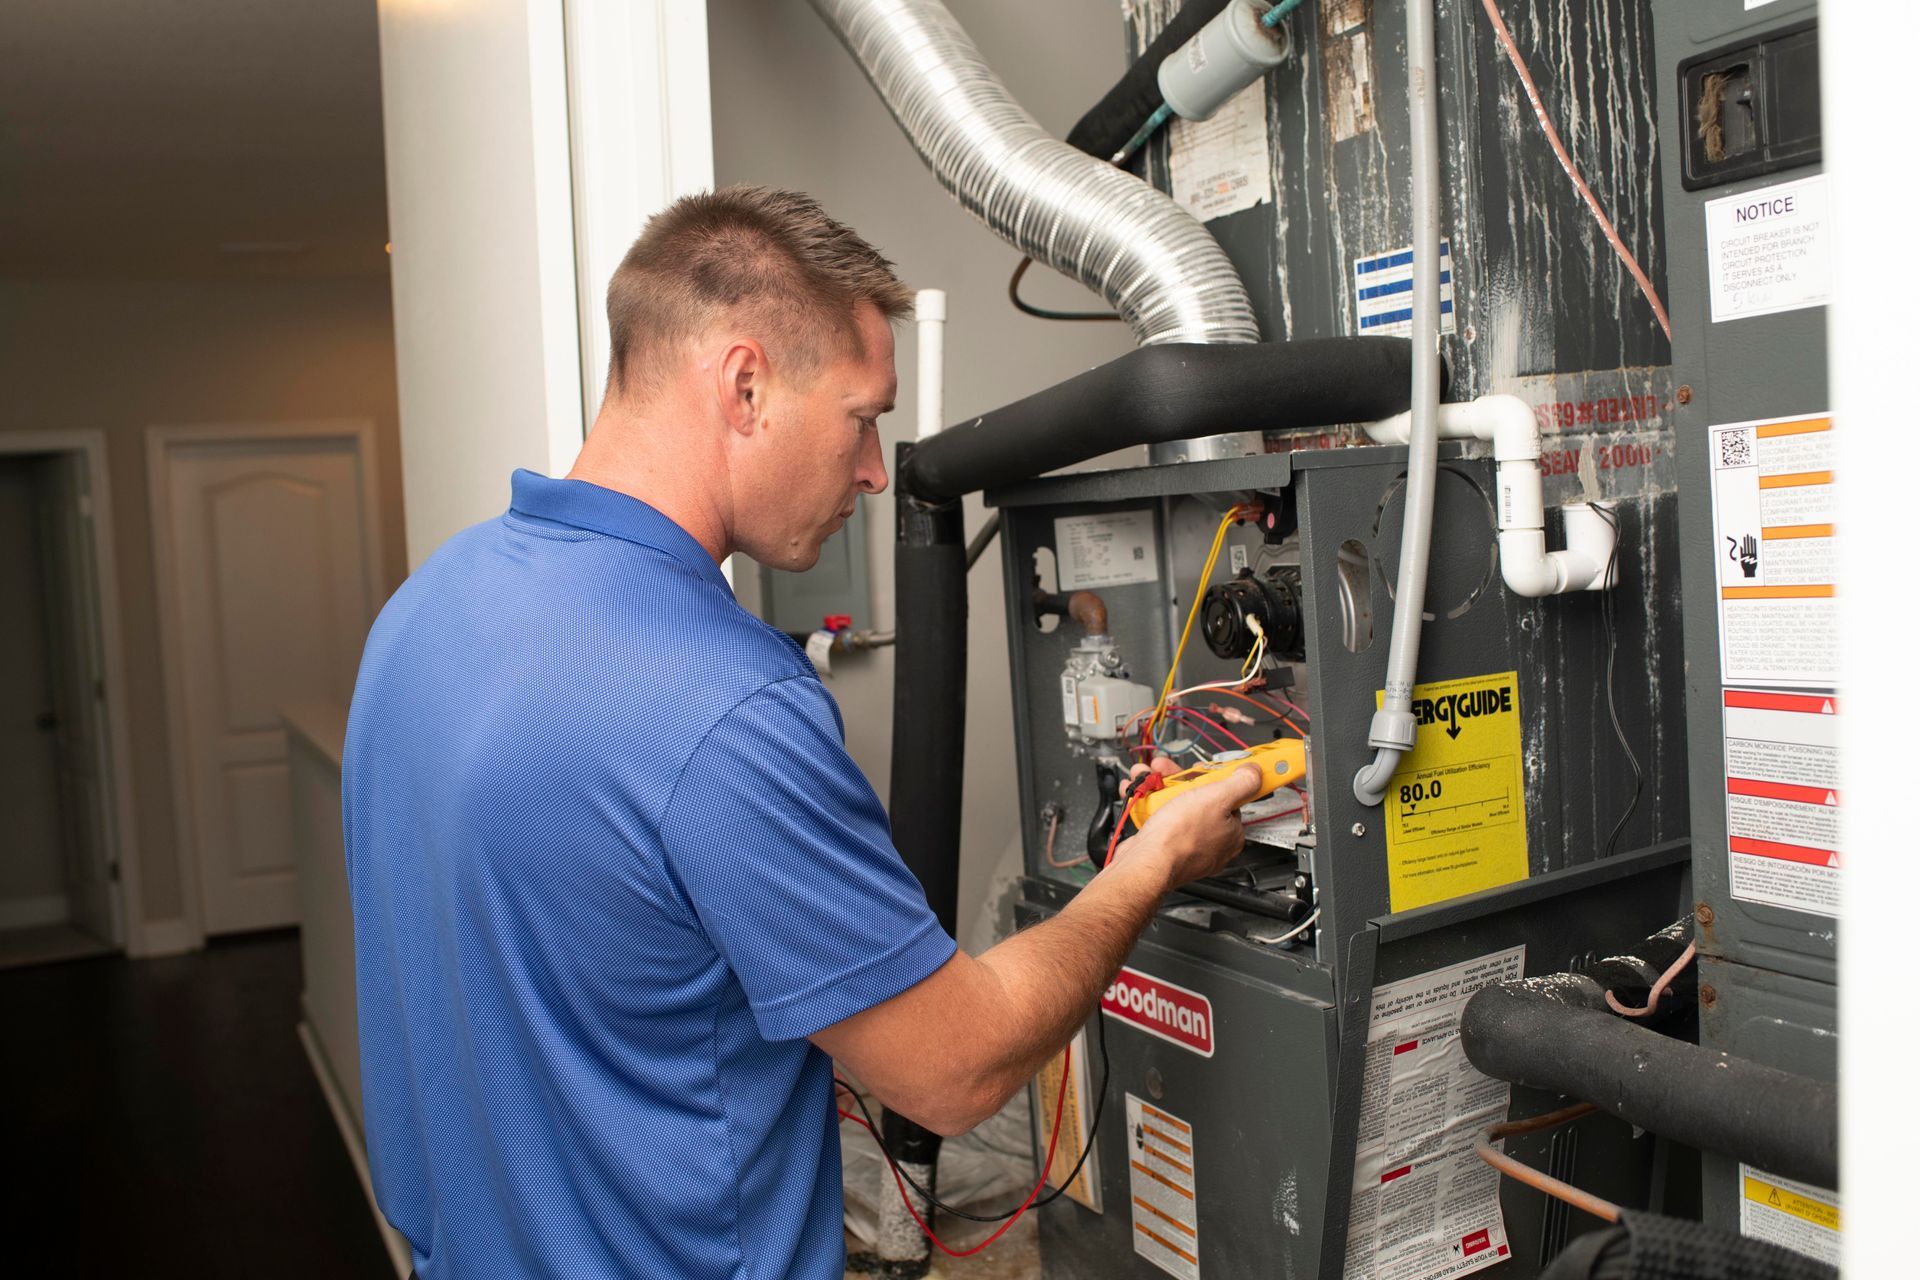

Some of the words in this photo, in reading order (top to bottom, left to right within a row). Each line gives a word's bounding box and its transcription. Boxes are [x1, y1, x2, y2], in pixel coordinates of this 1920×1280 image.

[1736, 196, 1794, 222] NOTICE
[1720, 236, 1750, 250] CIRCUIT
[1754, 228, 1791, 241] BREAKER
[1793, 226, 1801, 234] IS
[1803, 222, 1820, 232] NOT
[1722, 246, 1760, 259] INTENDED
[1762, 242, 1778, 252] FOR
[1780, 236, 1815, 248] BRANCH
[1722, 258, 1752, 271] CIRCUIT
[1755, 249, 1806, 262] PROTECTION
[1723, 273, 1729, 282] IT
[1731, 267, 1762, 280] SERVES
[1765, 266, 1776, 274] AS
[1723, 277, 1774, 292] DISCONNECT
[1776, 272, 1798, 284] ONLY
[1411, 686, 1512, 729] ERGYGUIDE
[1754, 743, 1786, 752] MONOXIDE
[1788, 746, 1823, 755] POISONING
[1445, 767, 1468, 775] Utilization
[1468, 763, 1490, 771] Efficiency
[1400, 780, 1442, 804] 80.0
[1730, 796, 1752, 805] RISQUE
[1733, 856, 1756, 866] RIESGO
[1460, 982, 1484, 996] SAFETY
[1438, 992, 1448, 1000] not
[1422, 1032, 1447, 1044] APPLIANCE
[1466, 1236, 1486, 1249] WARNING
[1474, 1252, 1487, 1262] YOUR
[1487, 1250, 1498, 1258] FOR
[1442, 1264, 1456, 1274] READ
[1456, 1258, 1474, 1269] SAFETY
